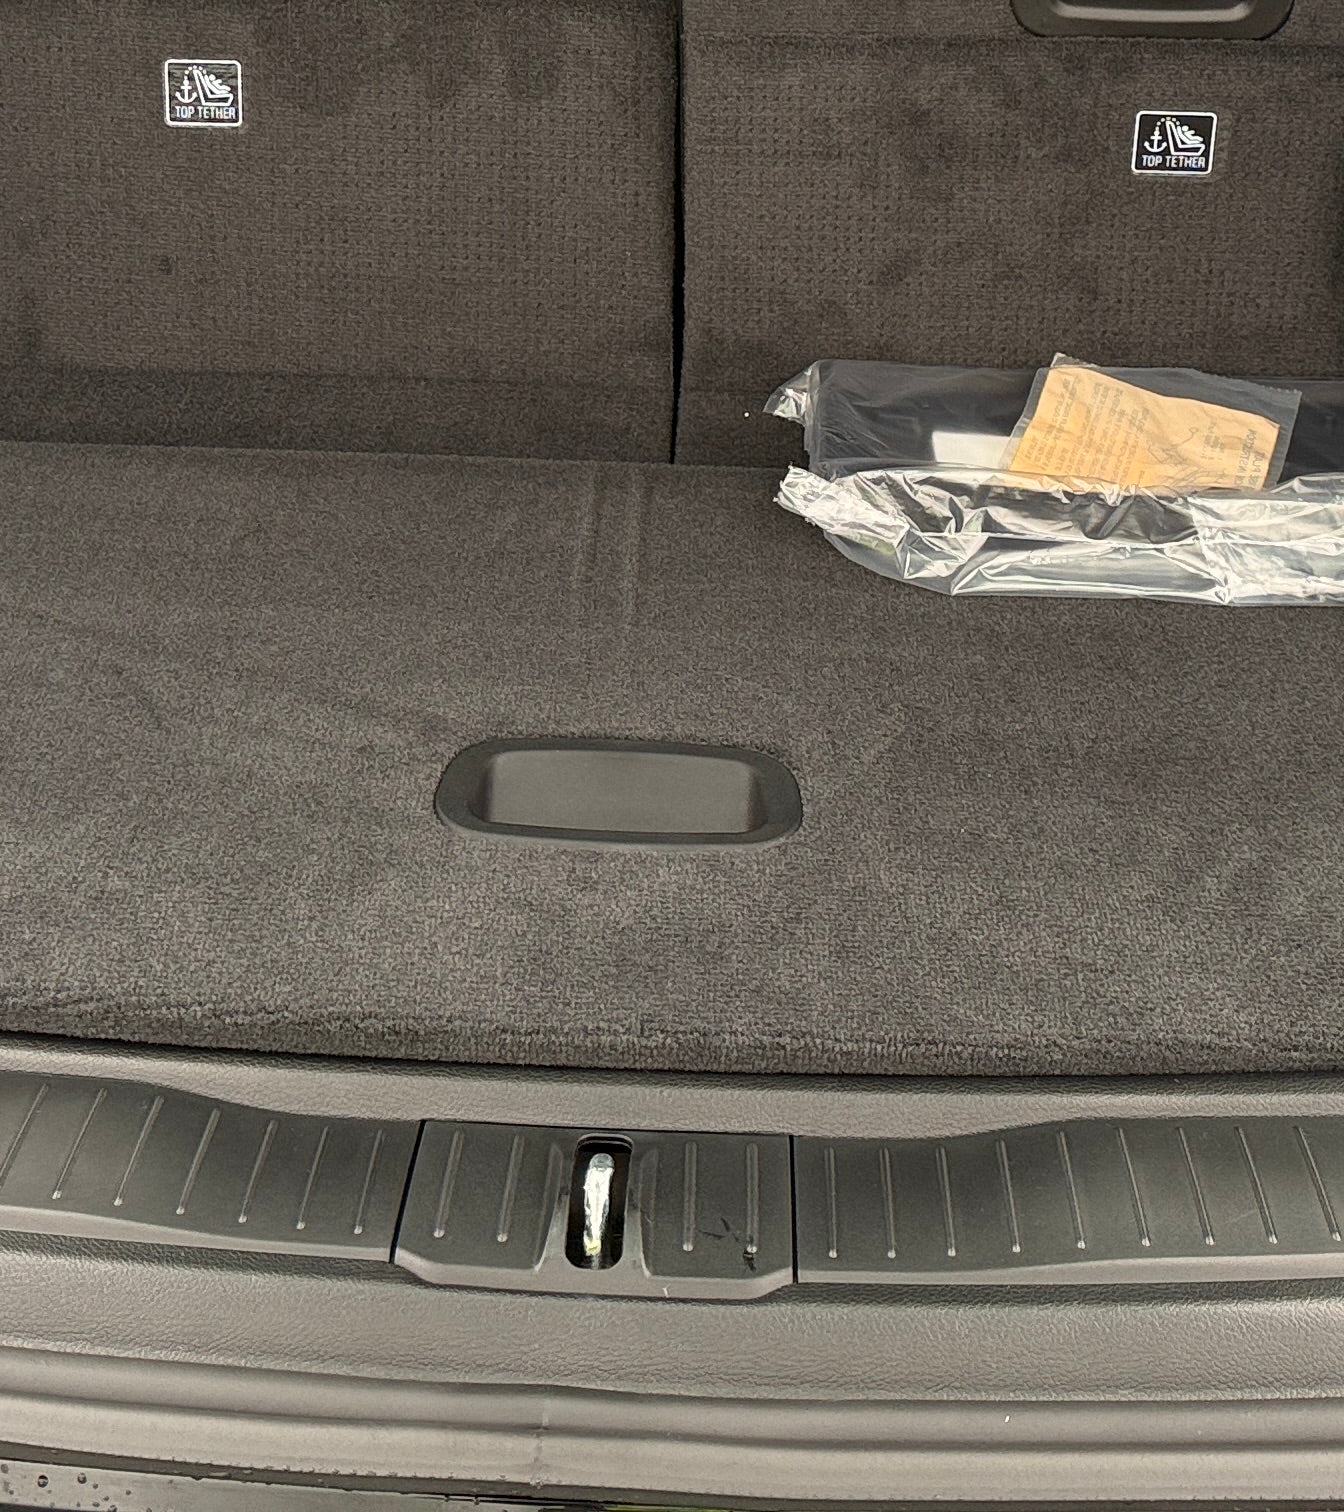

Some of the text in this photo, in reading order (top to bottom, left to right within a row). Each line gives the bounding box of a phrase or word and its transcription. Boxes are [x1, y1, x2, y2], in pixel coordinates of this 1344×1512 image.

[175, 105, 236, 120] TOP TETHER
[1141, 154, 1206, 169] TOP TETHER
